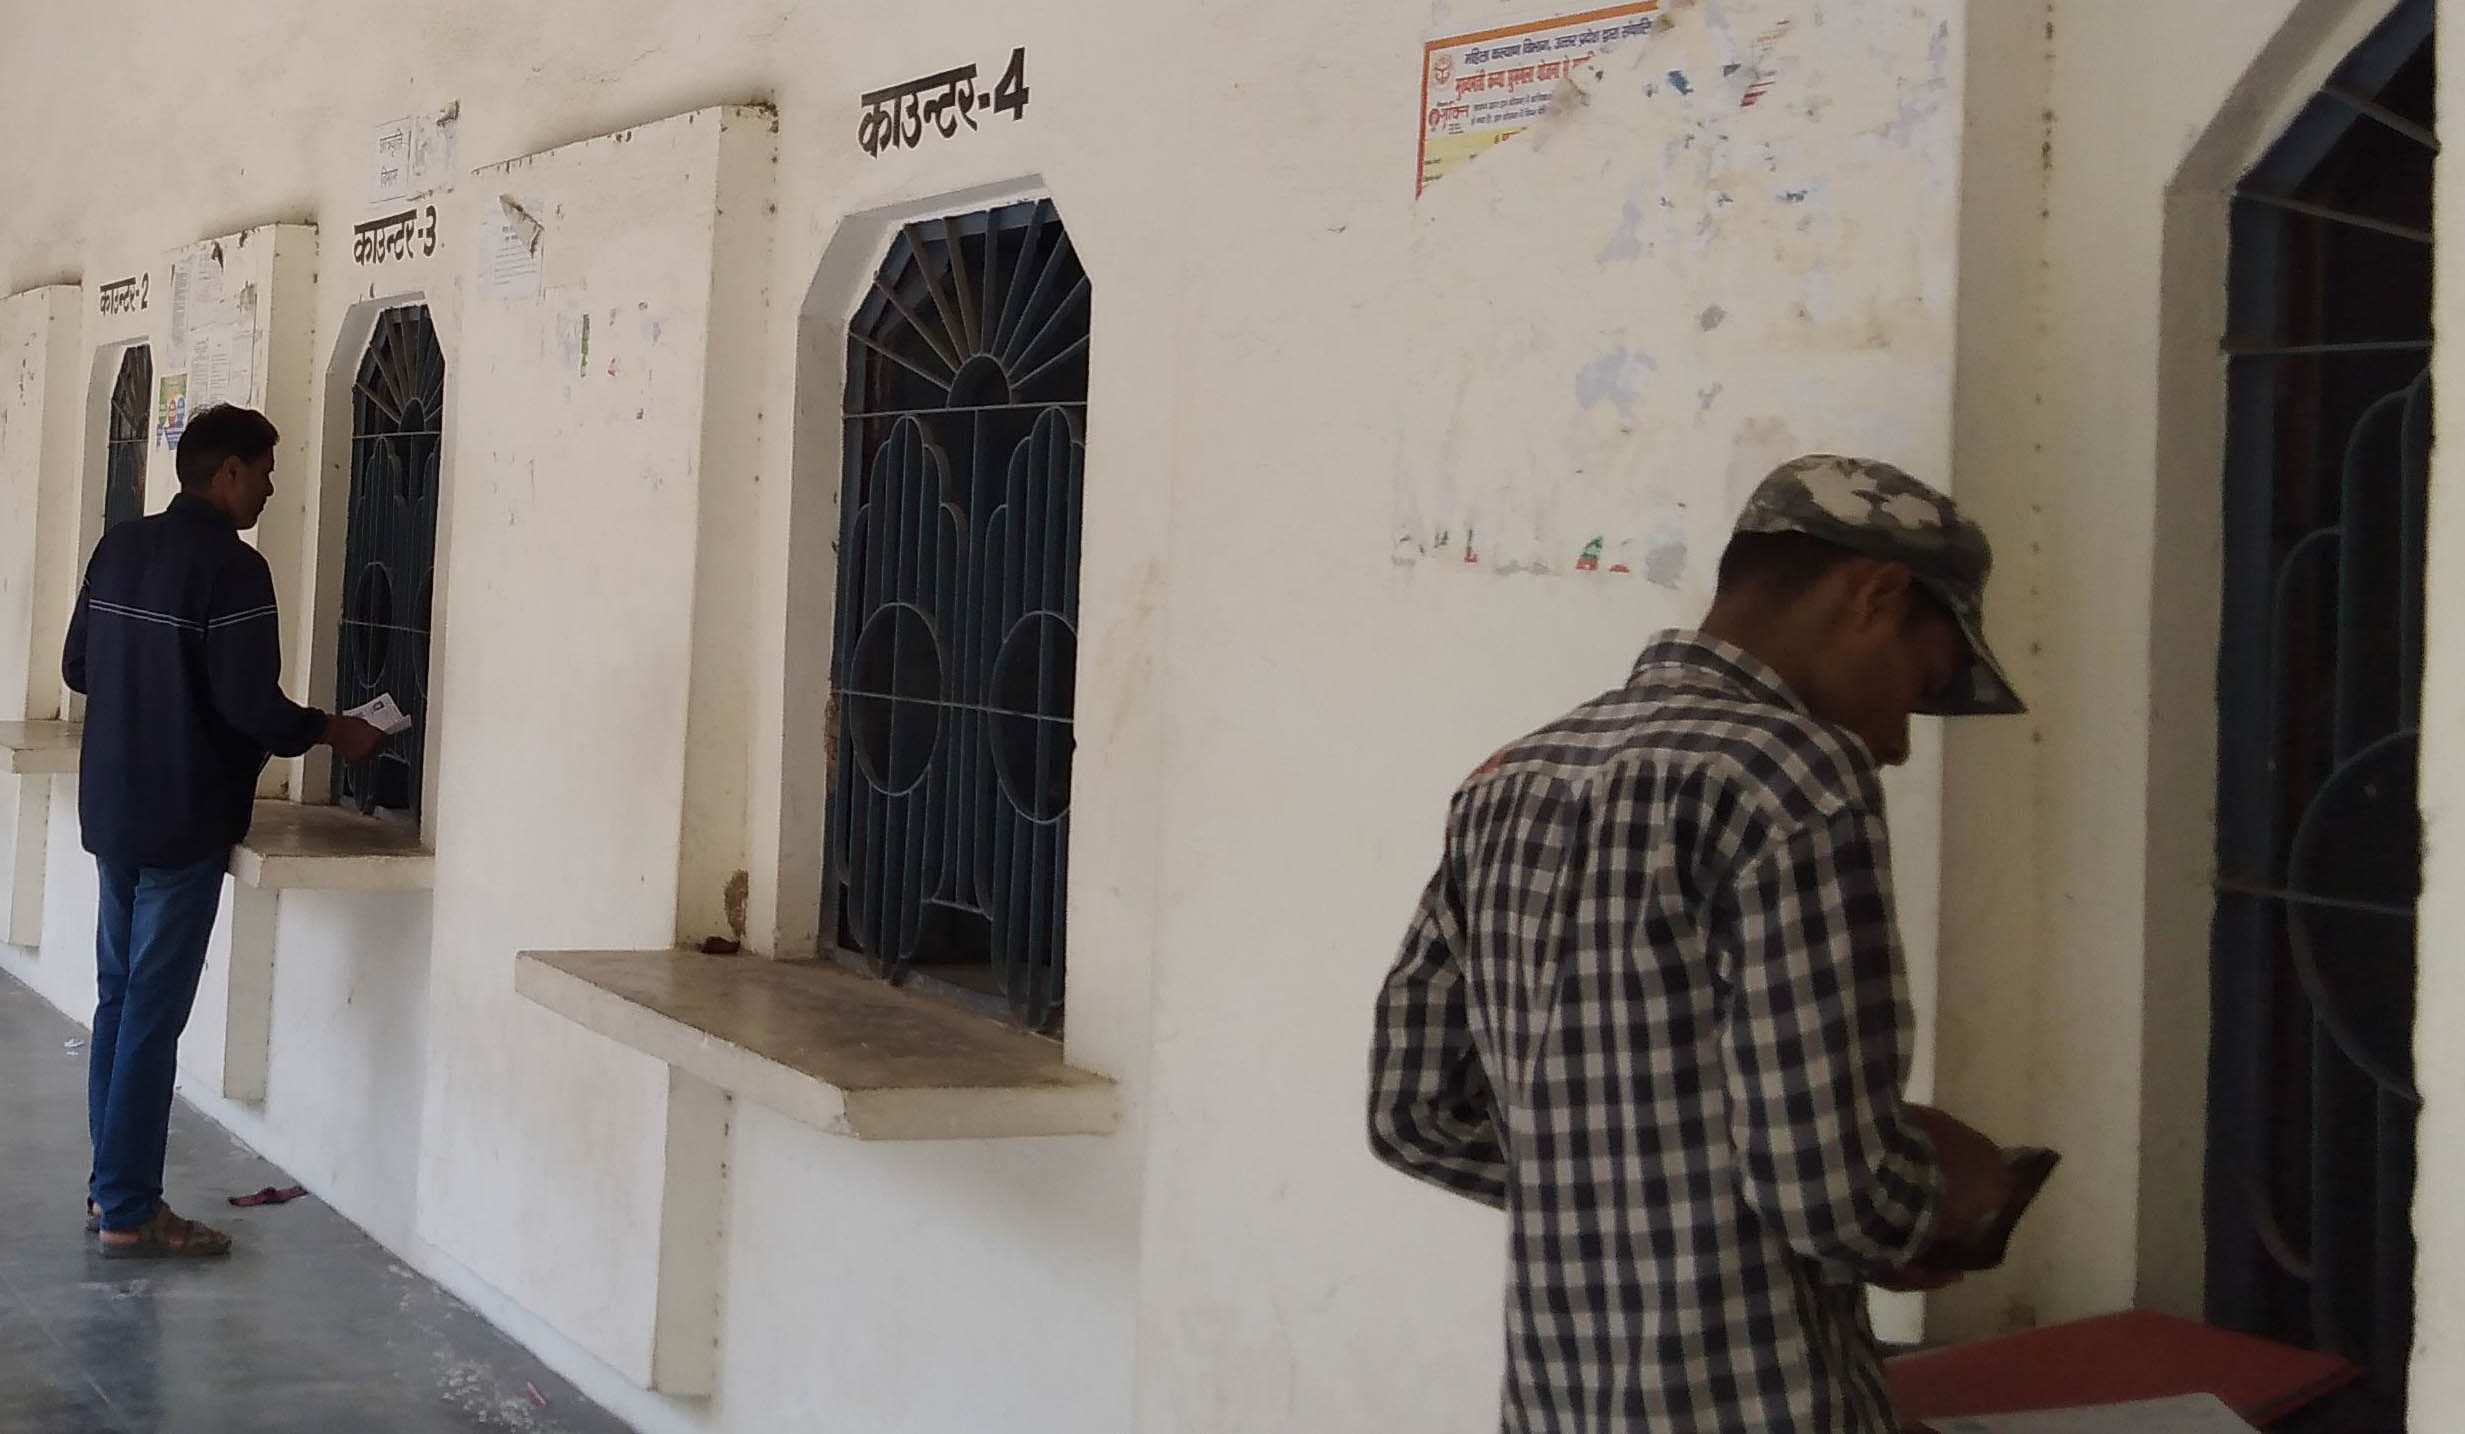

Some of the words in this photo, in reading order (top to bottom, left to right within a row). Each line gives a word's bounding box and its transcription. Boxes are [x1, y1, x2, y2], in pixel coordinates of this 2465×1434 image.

[1464, 47, 1490, 65] महिला
[1491, 44, 1521, 61] कल्याण
[1554, 35, 1577, 49] उत्तर
[1579, 28, 1600, 47] प्रदेश
